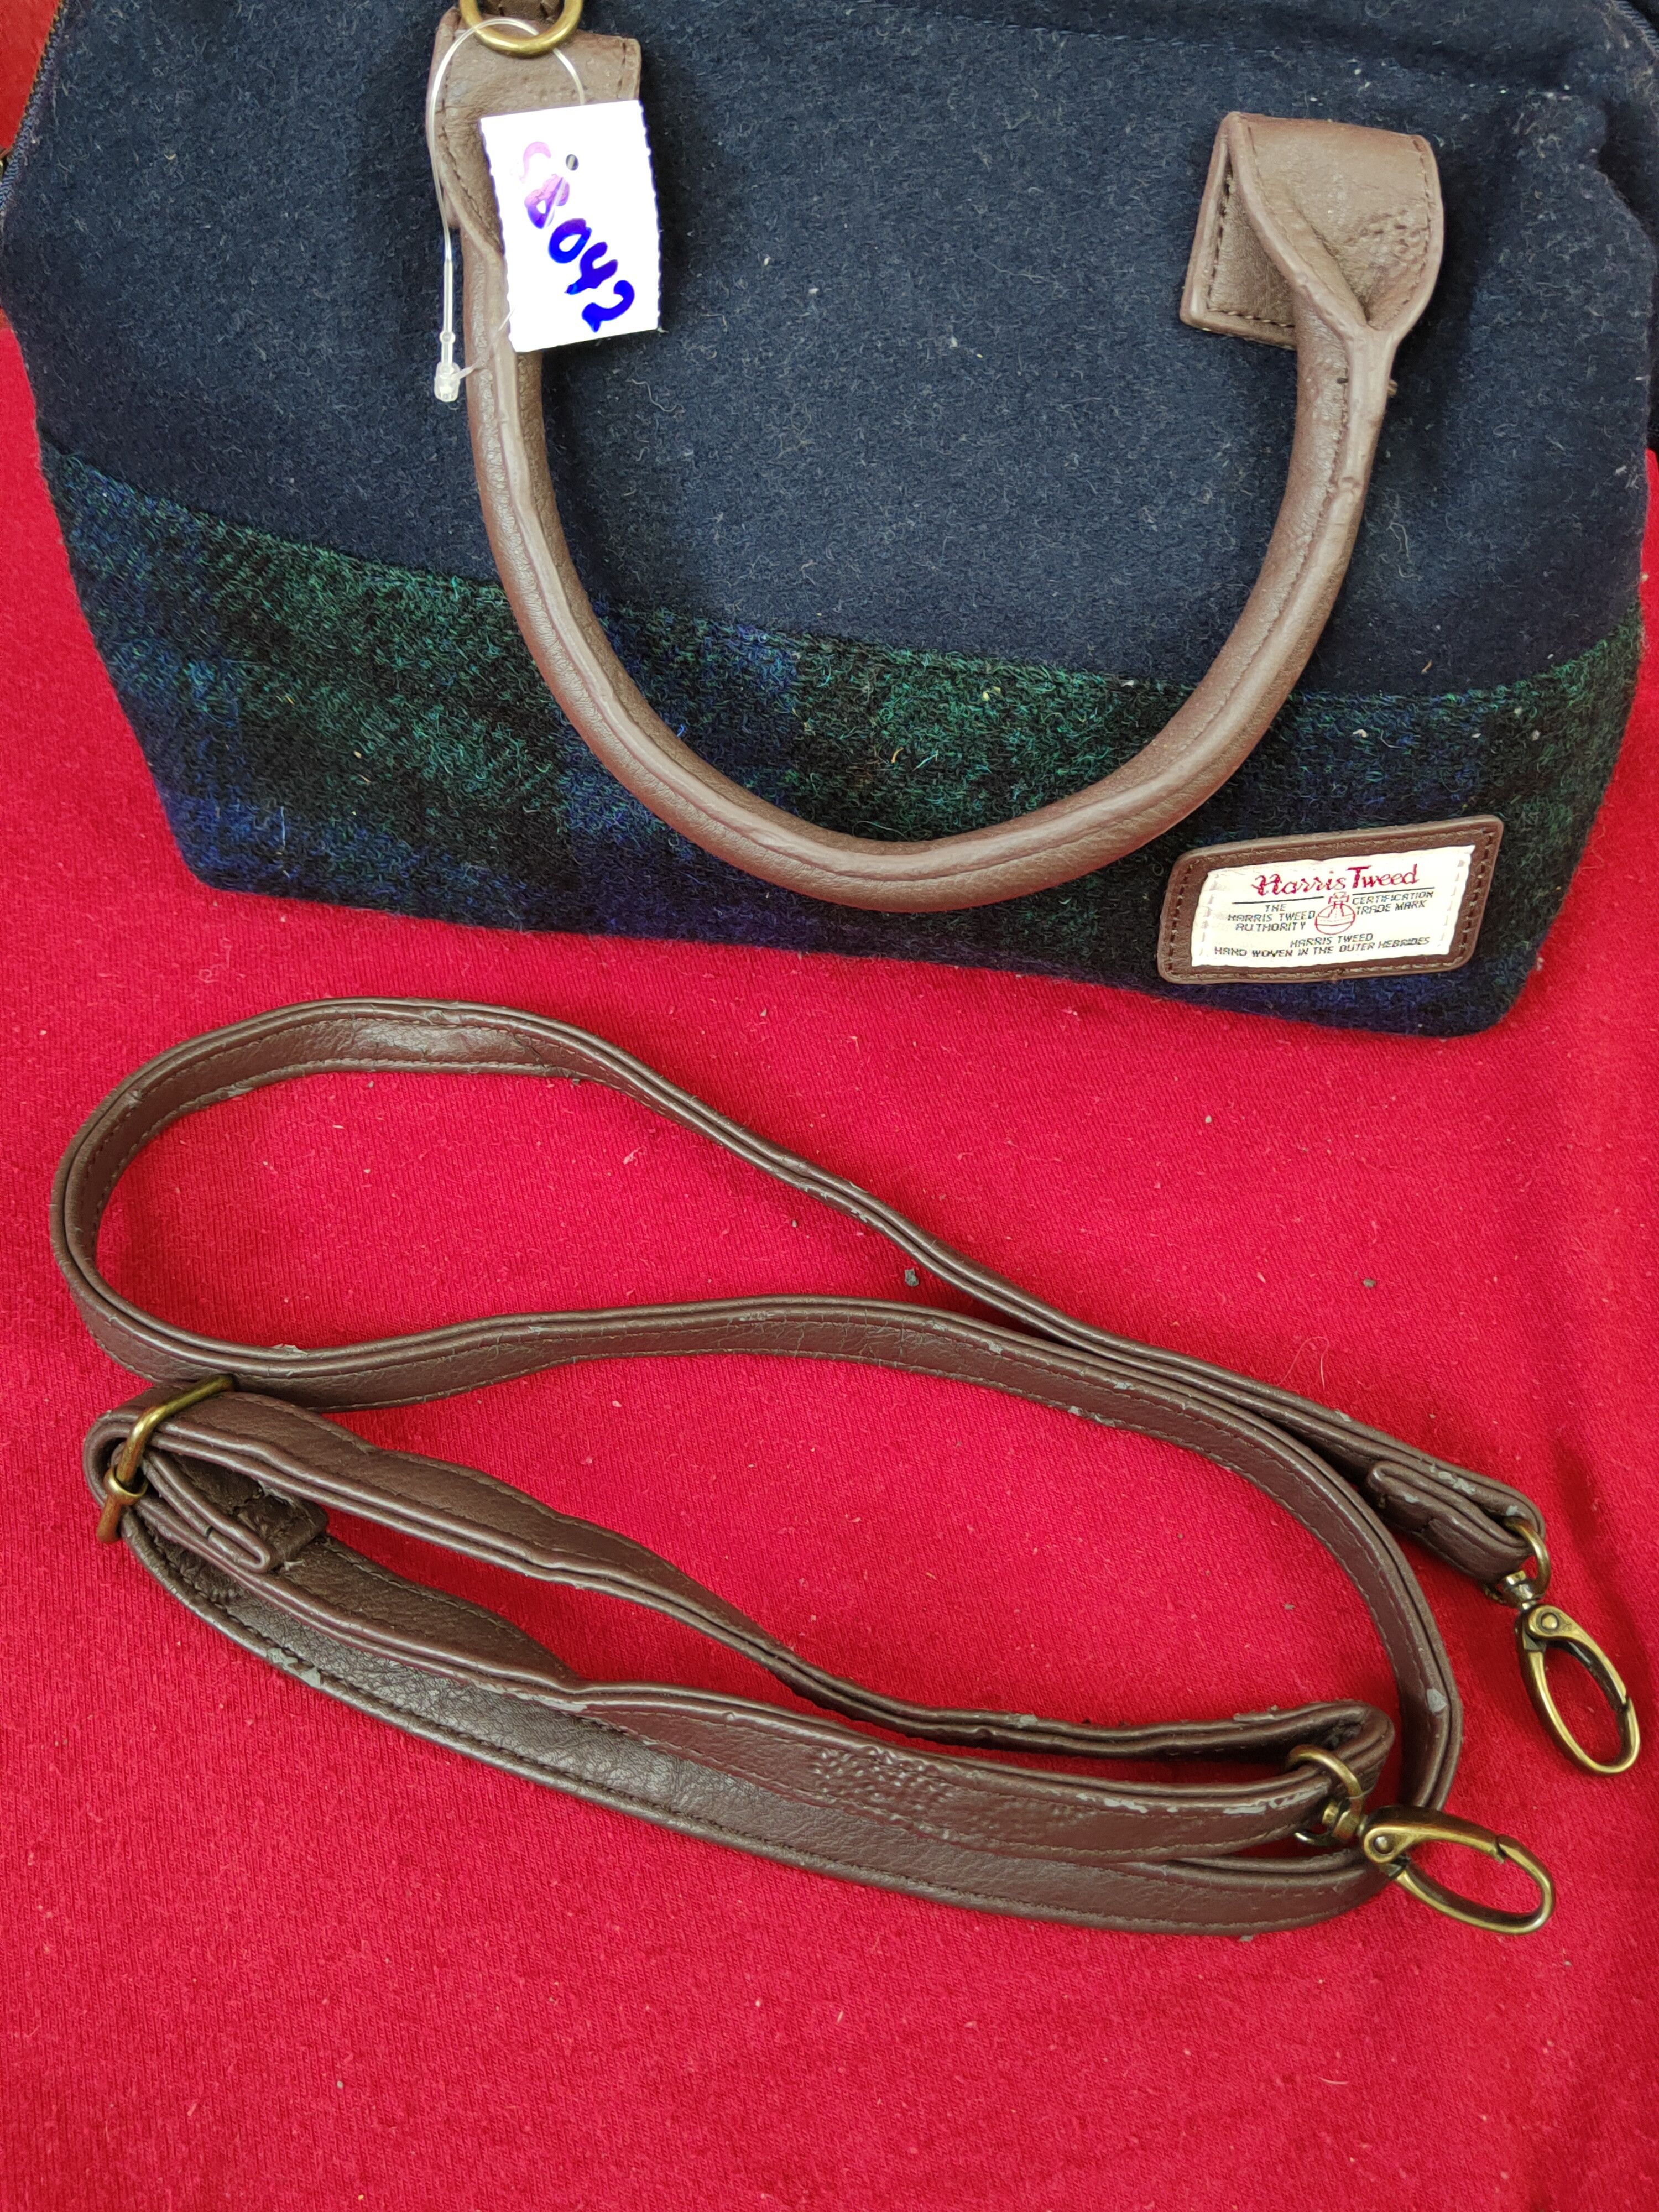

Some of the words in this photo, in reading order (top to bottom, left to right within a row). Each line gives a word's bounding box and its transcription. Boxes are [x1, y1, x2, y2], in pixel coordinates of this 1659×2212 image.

[1251, 870, 1346, 896] Harris
[1345, 864, 1420, 889] Tweed
[1352, 891, 1434, 905] CERTIFICATION
[1265, 904, 1287, 912] THE
[1356, 903, 1392, 915] TRADE
[1395, 900, 1427, 911] MARK
[1228, 914, 1273, 922] HARRIS
[1280, 910, 1316, 921] TWEED
[1235, 921, 1306, 932] AUTHORITY
[1214, 946, 1248, 956] HAND
[1298, 948, 1309, 956] IN
[1313, 946, 1334, 955] THE
[1339, 942, 1375, 952] OUTER
[1378, 937, 1430, 949] HEBRIDES
[1290, 937, 1332, 948] HARRIS
[1338, 933, 1374, 944] TWEED
